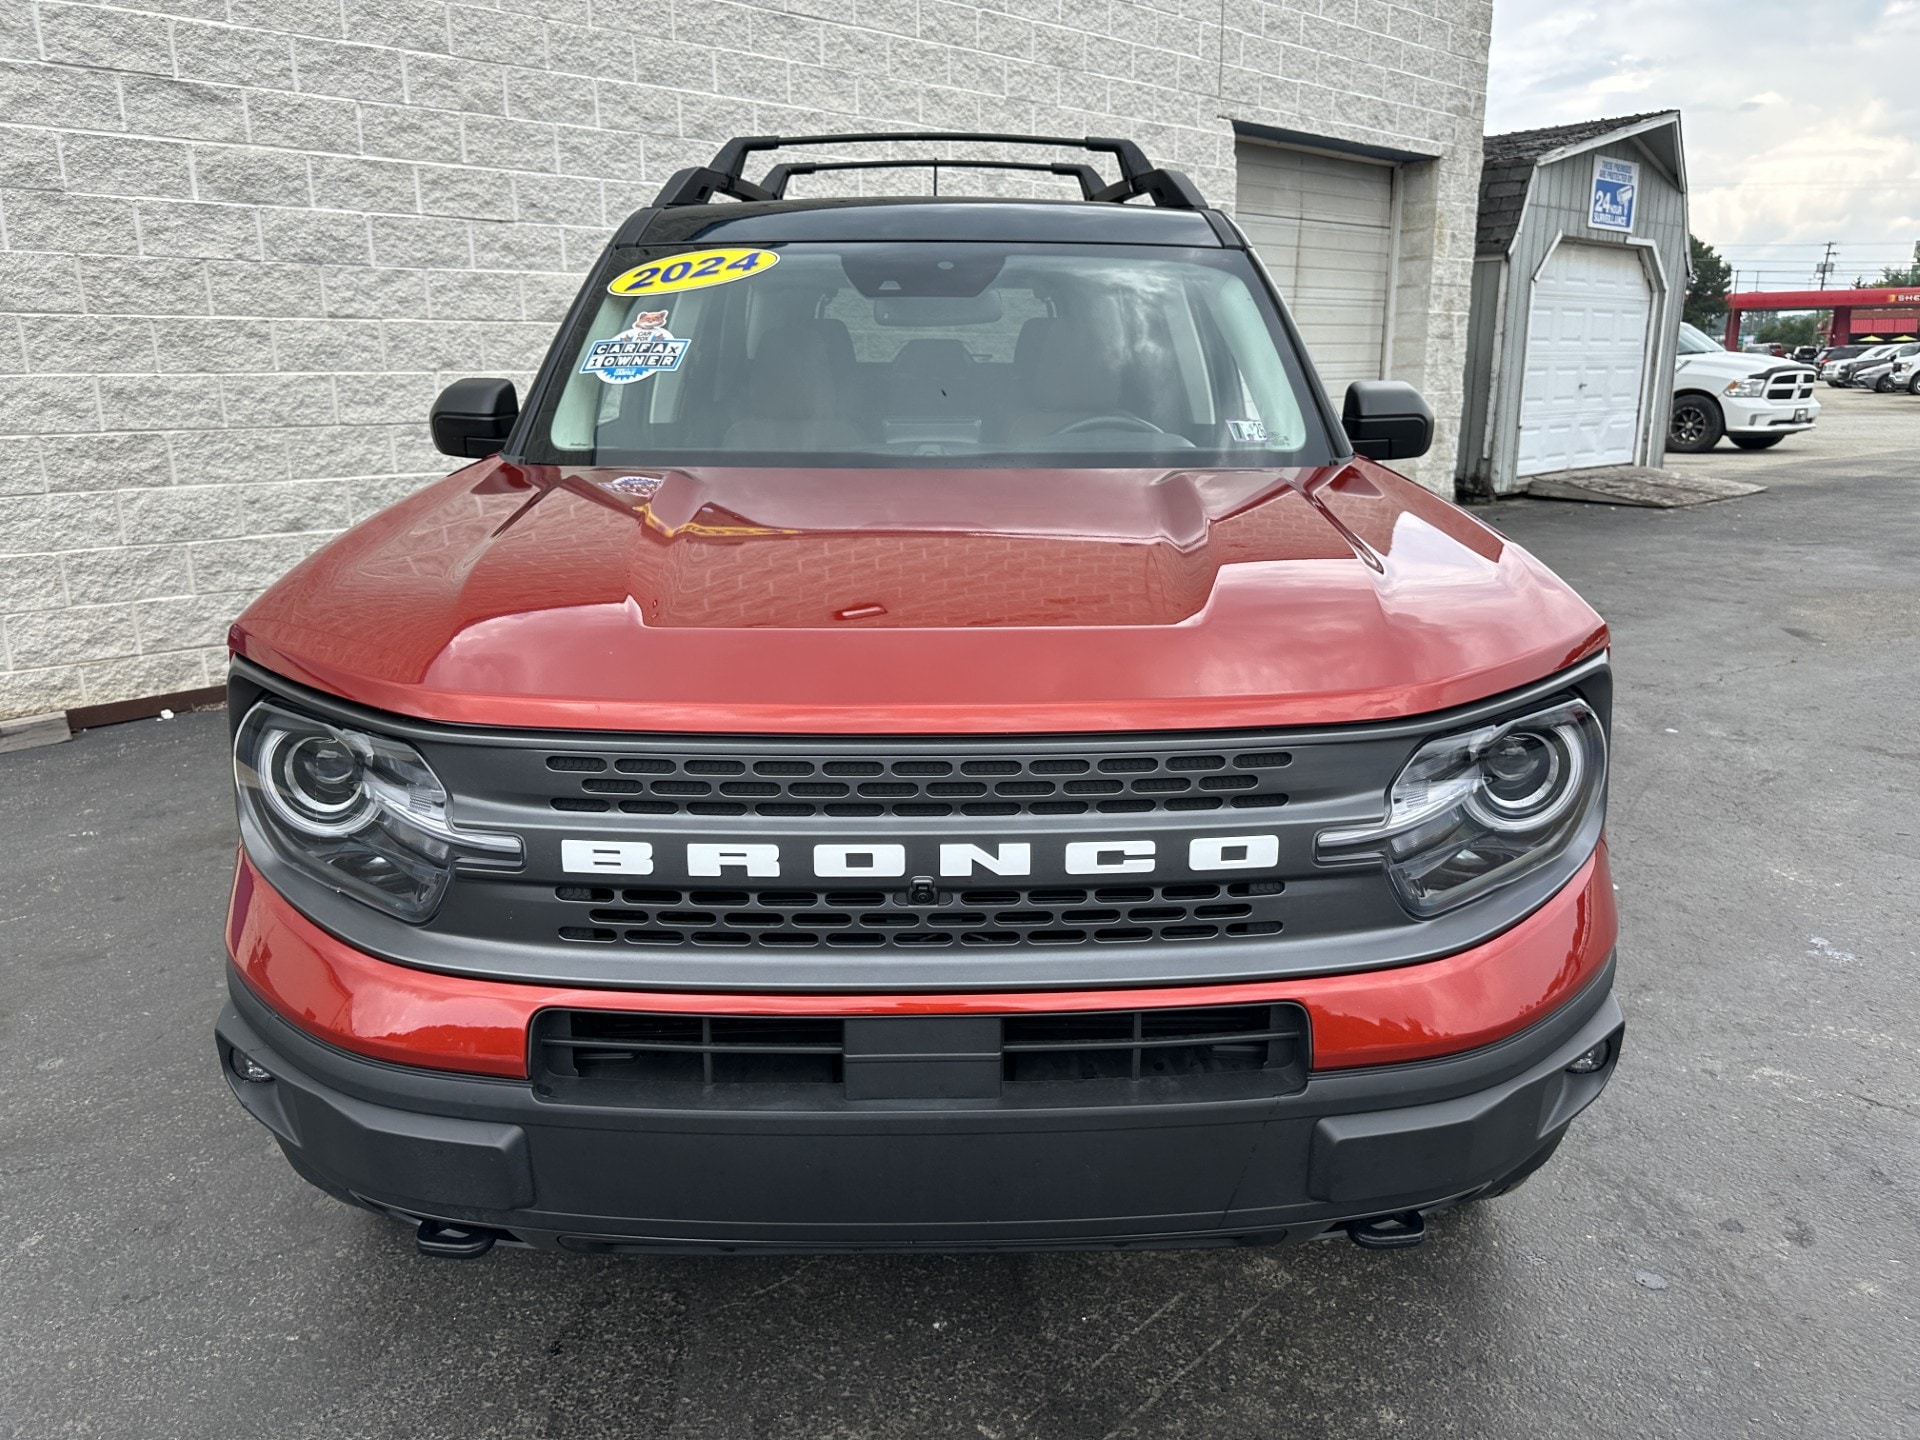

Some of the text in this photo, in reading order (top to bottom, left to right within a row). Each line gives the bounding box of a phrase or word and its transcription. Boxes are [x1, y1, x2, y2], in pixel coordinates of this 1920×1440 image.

[1595, 190, 1611, 213] 24
[1593, 212, 1627, 226] SURVEILLANCE
[624, 252, 761, 292] 2024
[595, 343, 680, 355] CARFAX
[590, 355, 675, 367] 1 OWNER
[561, 834, 1281, 879] BRONCO
